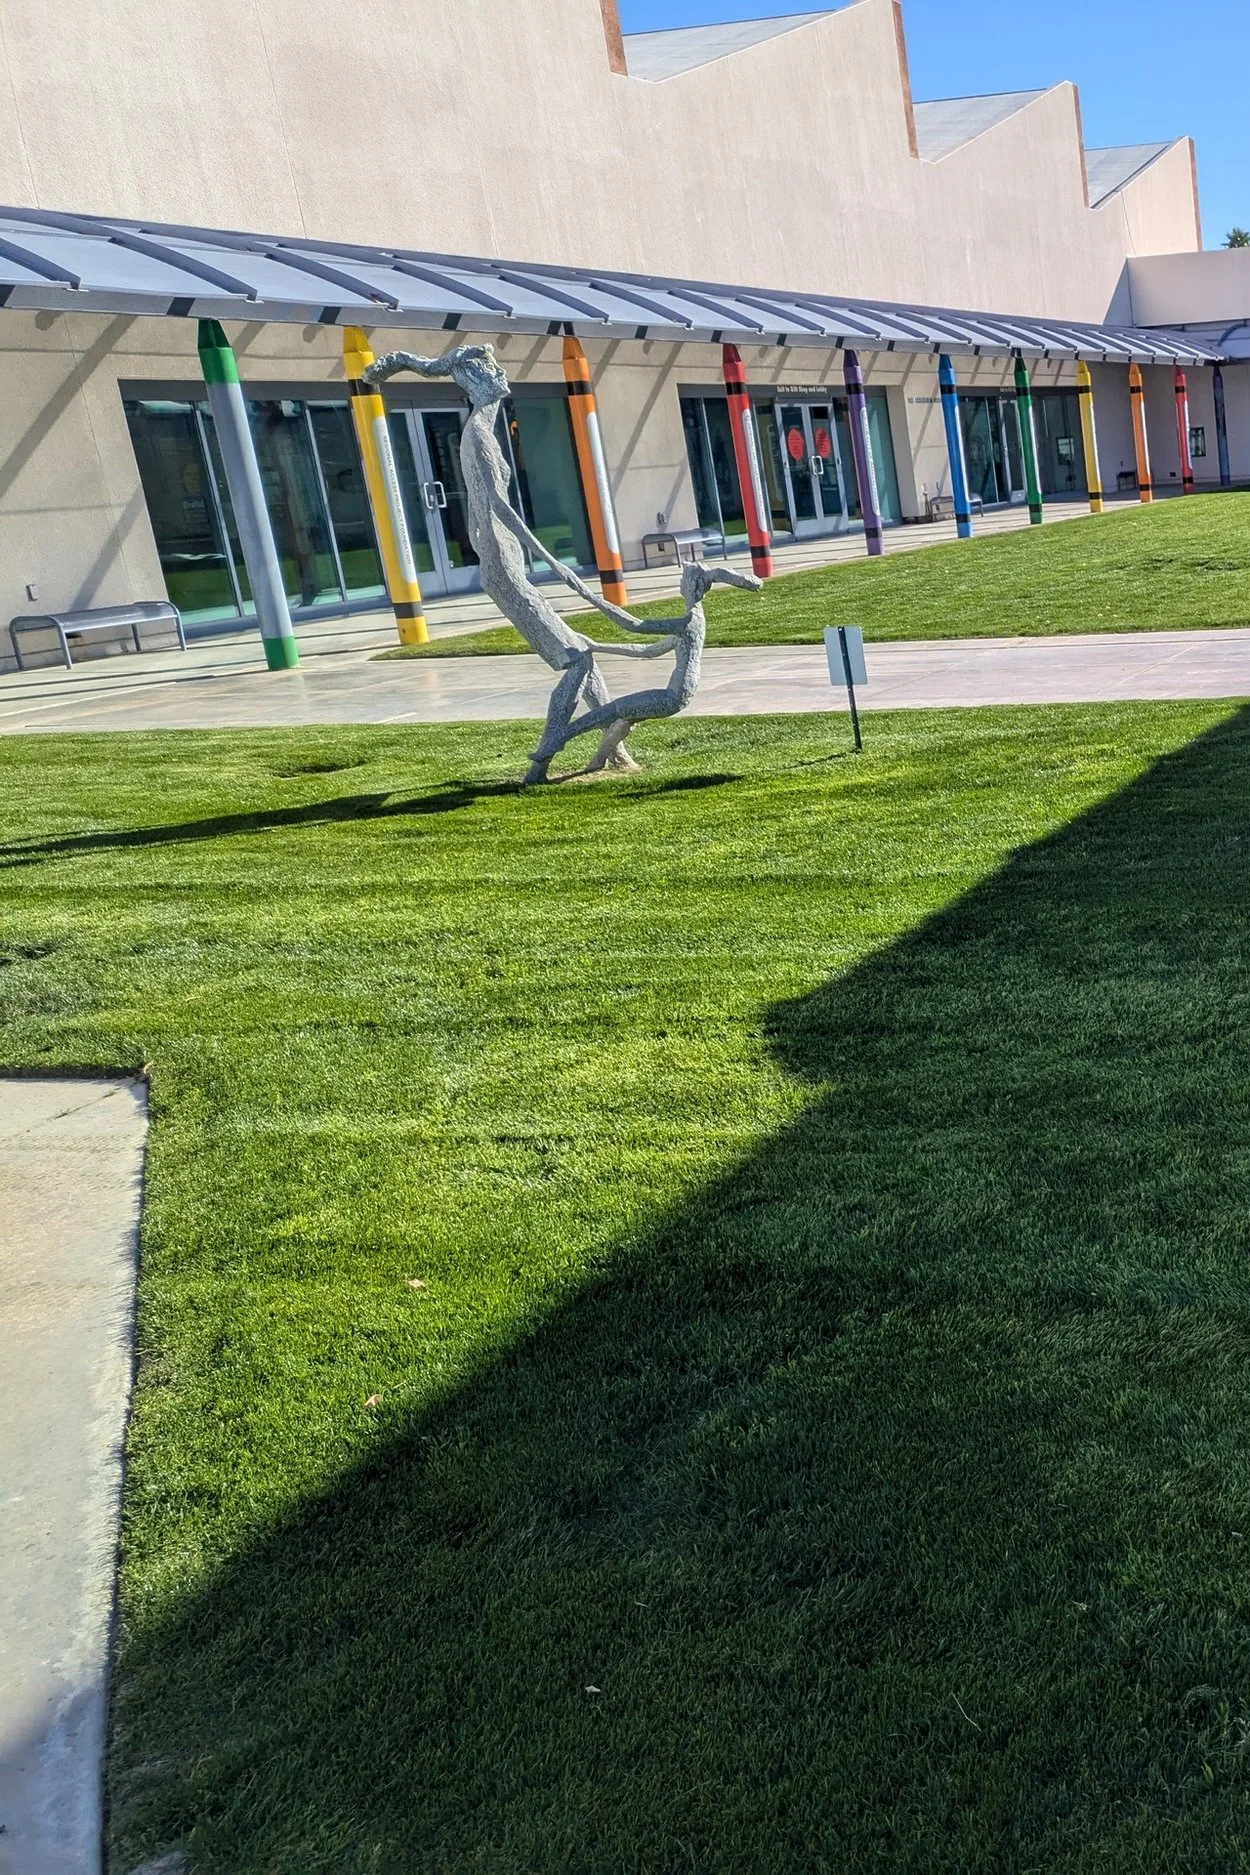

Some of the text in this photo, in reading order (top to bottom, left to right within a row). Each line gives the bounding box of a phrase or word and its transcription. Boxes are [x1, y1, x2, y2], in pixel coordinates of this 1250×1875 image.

[383, 435, 412, 565] REGIONAL ACCESS PROJECT FOUNDATION
